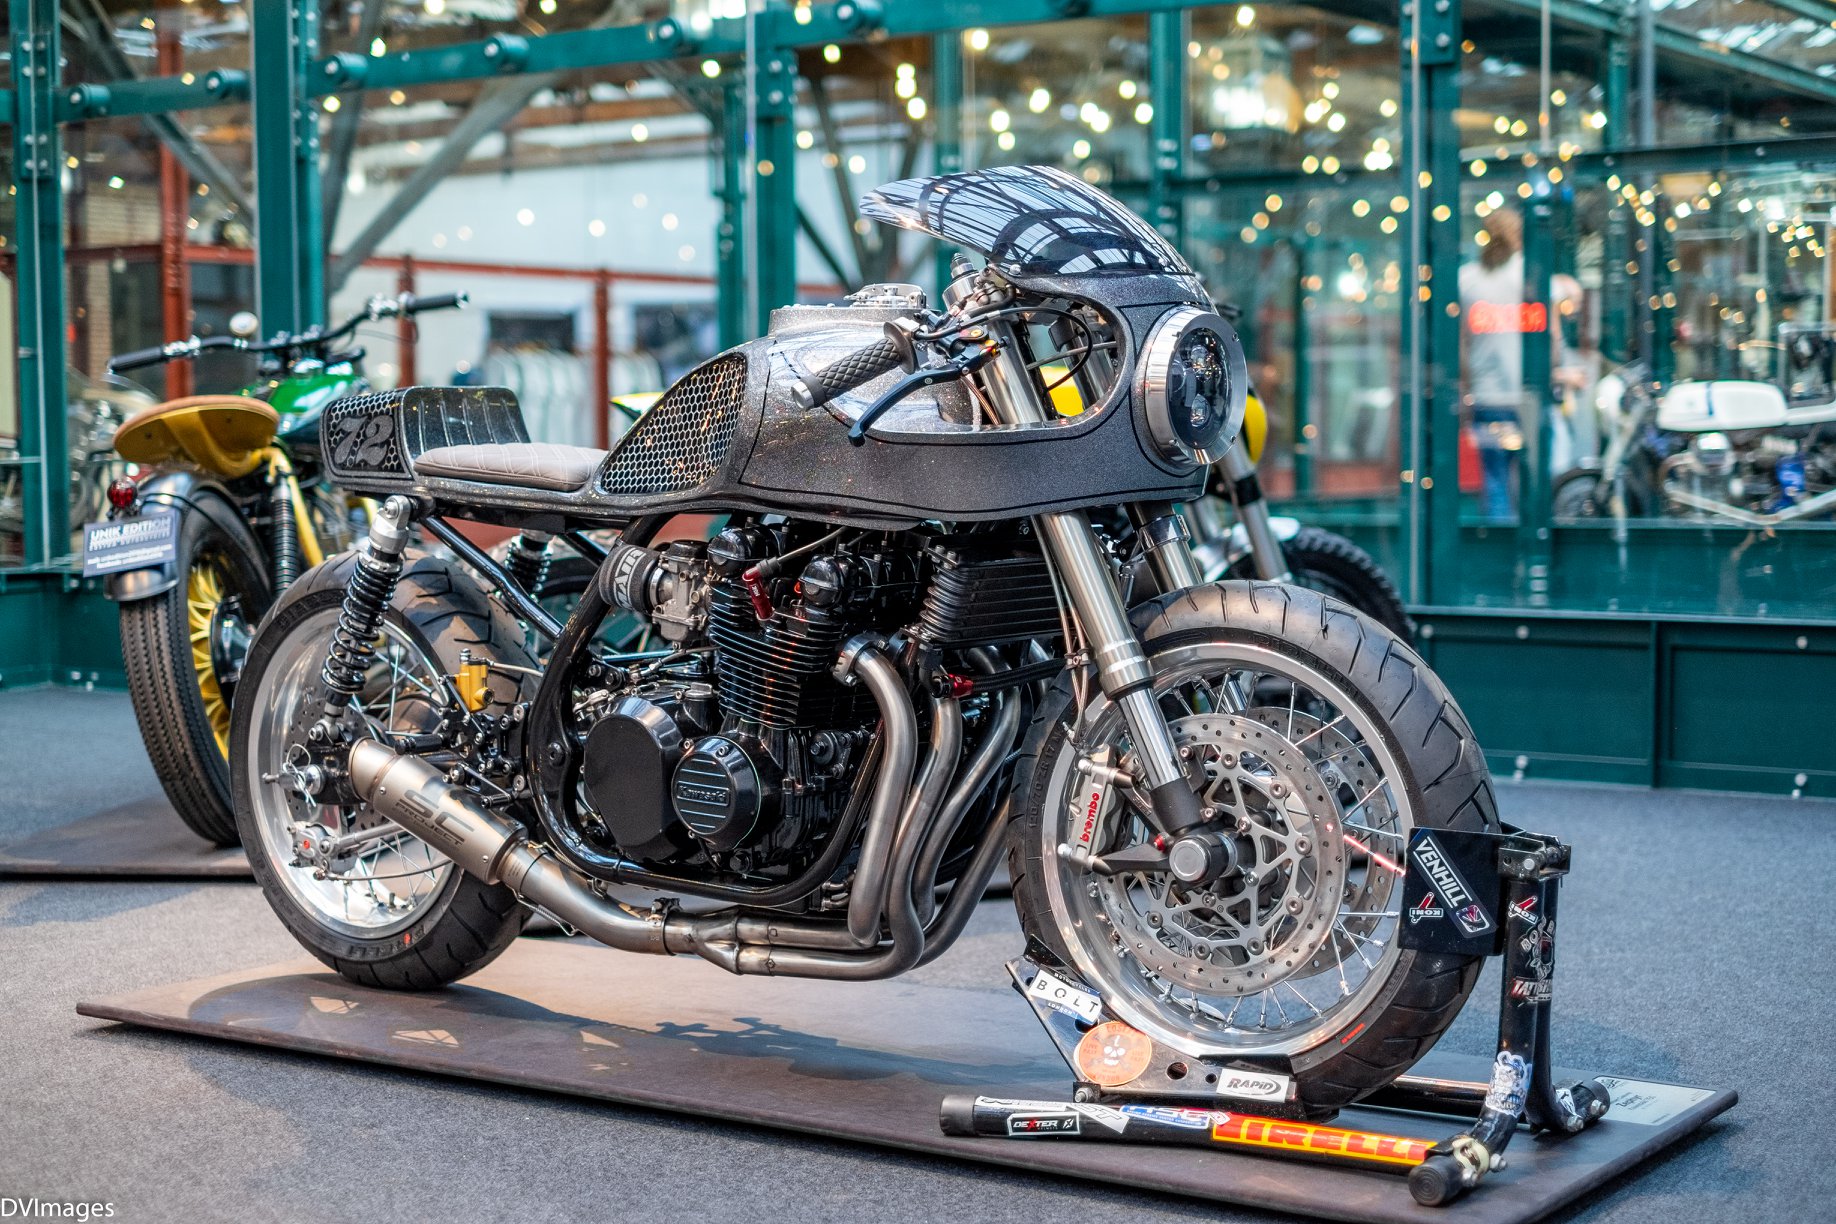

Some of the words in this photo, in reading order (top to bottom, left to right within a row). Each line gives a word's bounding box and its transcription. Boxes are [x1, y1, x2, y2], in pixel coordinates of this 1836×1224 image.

[334, 415, 394, 466] 72
[90, 525, 121, 540] UNIK
[122, 516, 171, 537] EDITION
[1040, 760, 1050, 779] ZR
[1045, 744, 1056, 760] 17
[394, 801, 463, 846] PROJECT
[399, 789, 475, 843] SC
[1079, 792, 1100, 843] brembo
[1415, 838, 1467, 907] VENHILL
[1411, 908, 1442, 917] KONI
[1036, 979, 1099, 1013] BOLT
[1013, 1118, 1059, 1131] DEXTER
